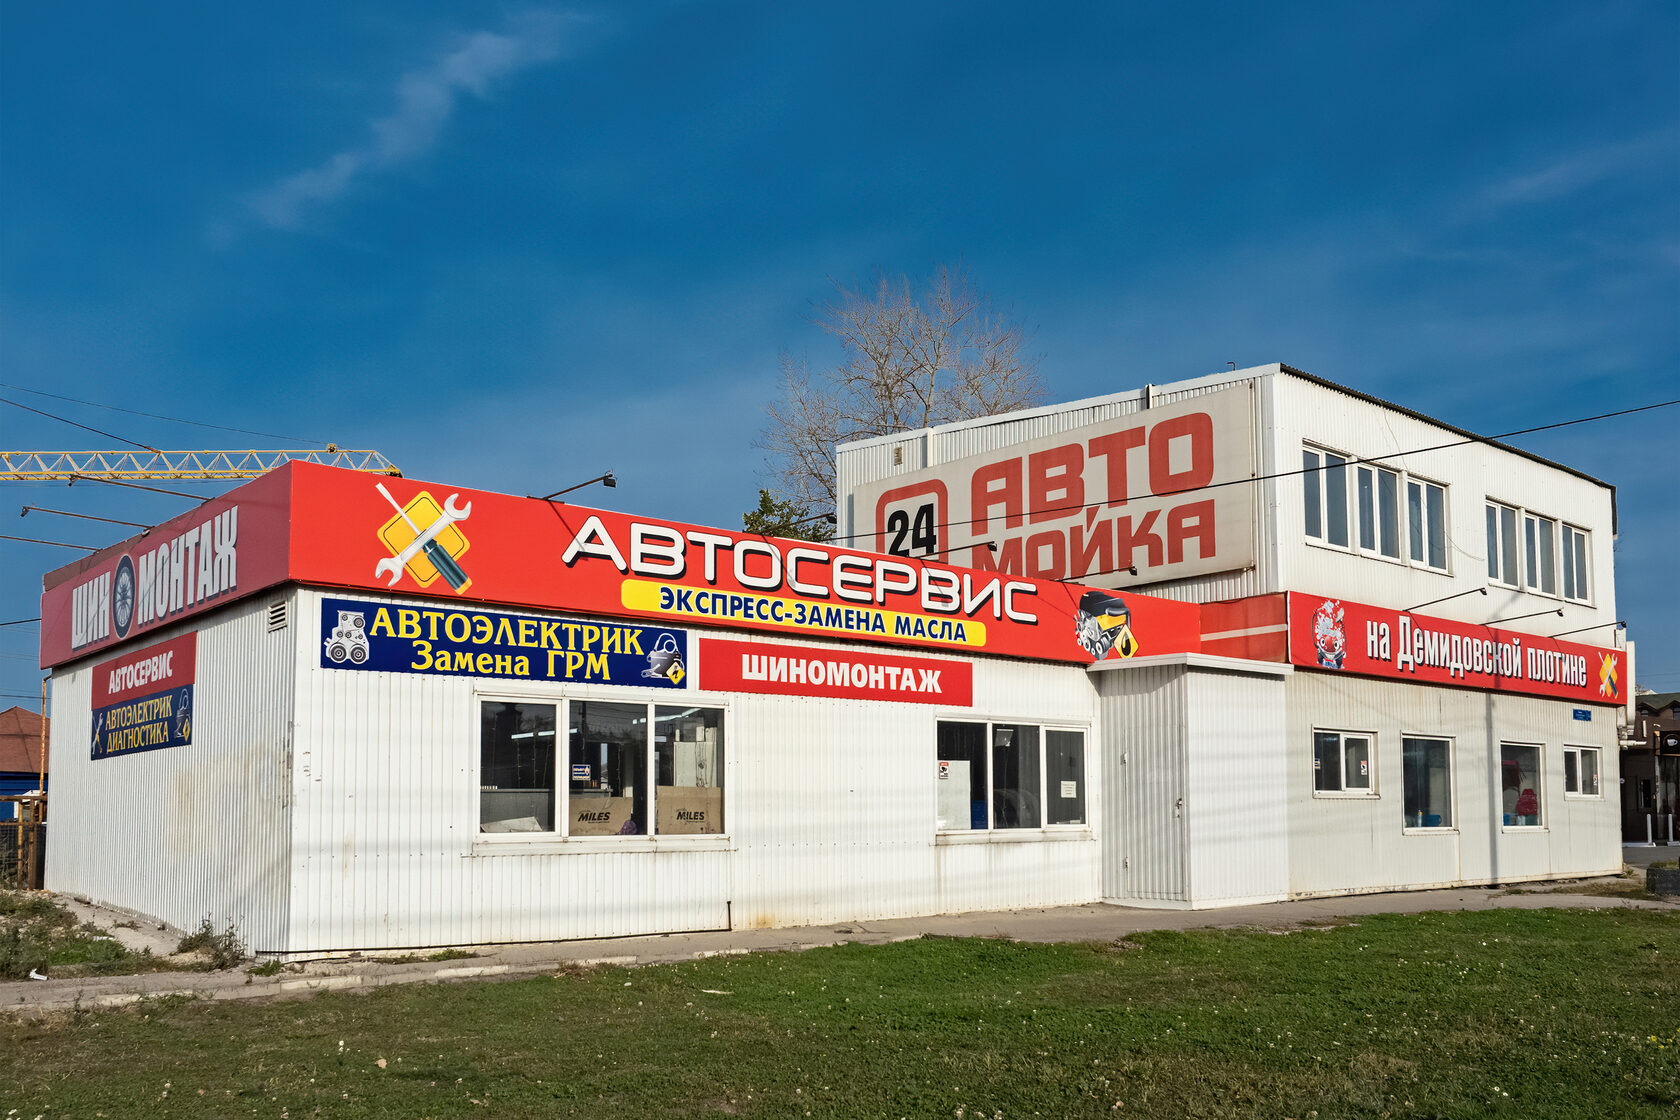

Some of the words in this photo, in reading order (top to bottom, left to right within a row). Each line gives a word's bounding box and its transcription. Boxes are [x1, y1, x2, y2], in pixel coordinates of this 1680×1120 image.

[971, 412, 1214, 536] АВТО
[888, 503, 936, 557] 24
[971, 499, 1216, 580] МОЙКА
[561, 515, 1037, 624] АВТОСЕРВИС
[370, 607, 644, 656] АВТОЭЛЕКТРИК
[660, 586, 885, 633] ЭКСПРЕСС-ЗАМЕНА
[894, 615, 967, 642] МАСЛА
[108, 650, 173, 694] АВТОСЕРВИС
[411, 641, 530, 676] Замена
[546, 650, 611, 681] ГРМ
[742, 653, 942, 693] ШИНОМОНТАЖ
[1366, 620, 1391, 662] на
[1397, 616, 1523, 678] Демидовской
[1527, 646, 1588, 687] плотине
[105, 695, 172, 730] АВТОЭЛЕКТРИК
[107, 721, 169, 753] ДИАГНОСТИКА
[578, 811, 611, 822] MILES
[676, 811, 705, 821] MILES
